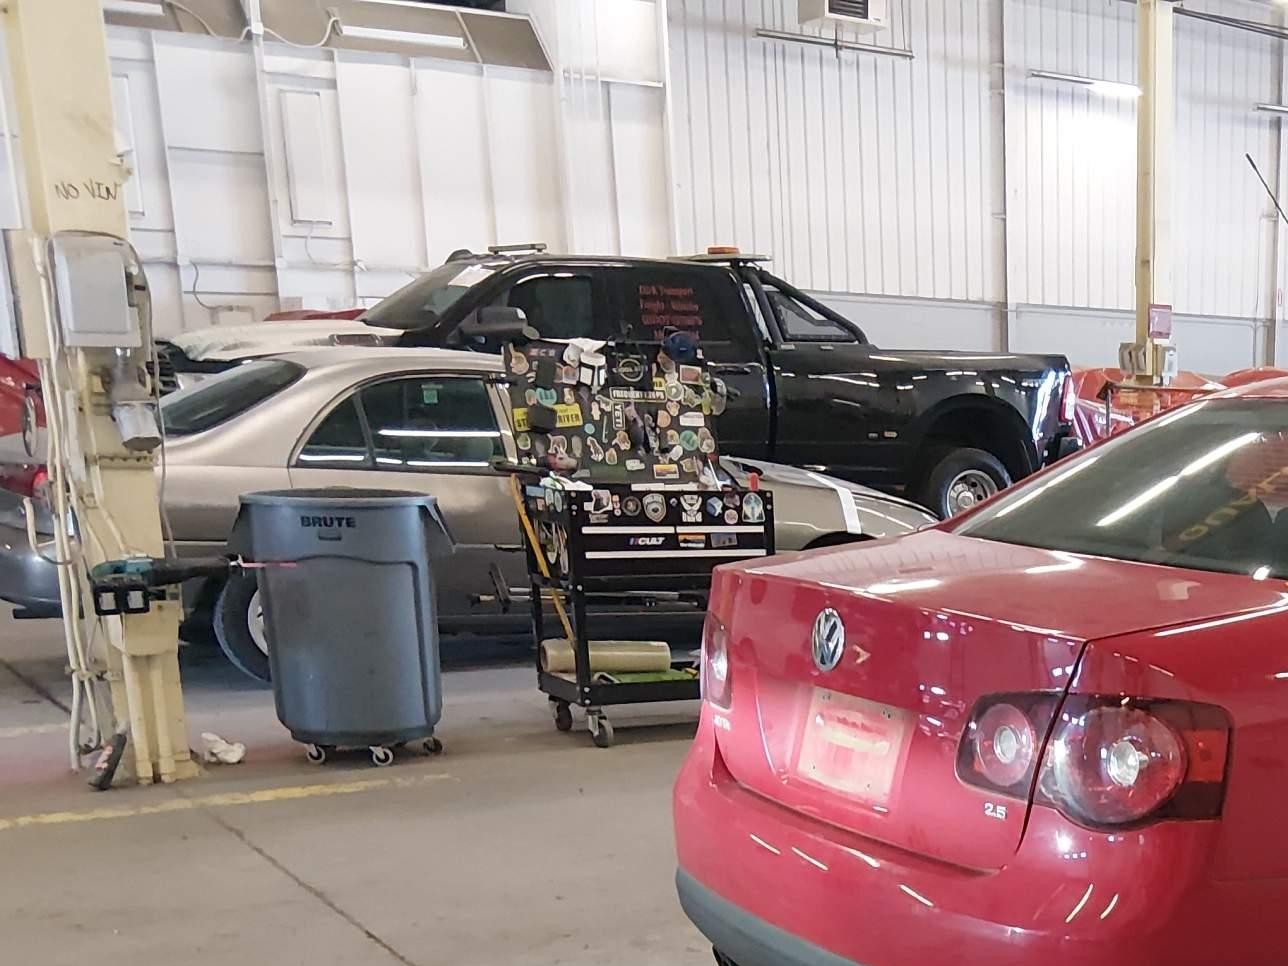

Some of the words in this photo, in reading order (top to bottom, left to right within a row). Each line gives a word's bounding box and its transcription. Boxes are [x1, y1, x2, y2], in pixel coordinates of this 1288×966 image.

[55, 181, 80, 200] NO
[83, 178, 120, 200] VIN
[614, 404, 623, 428] YETI
[300, 516, 356, 528] BRUTE
[984, 802, 1006, 819] 2.5
